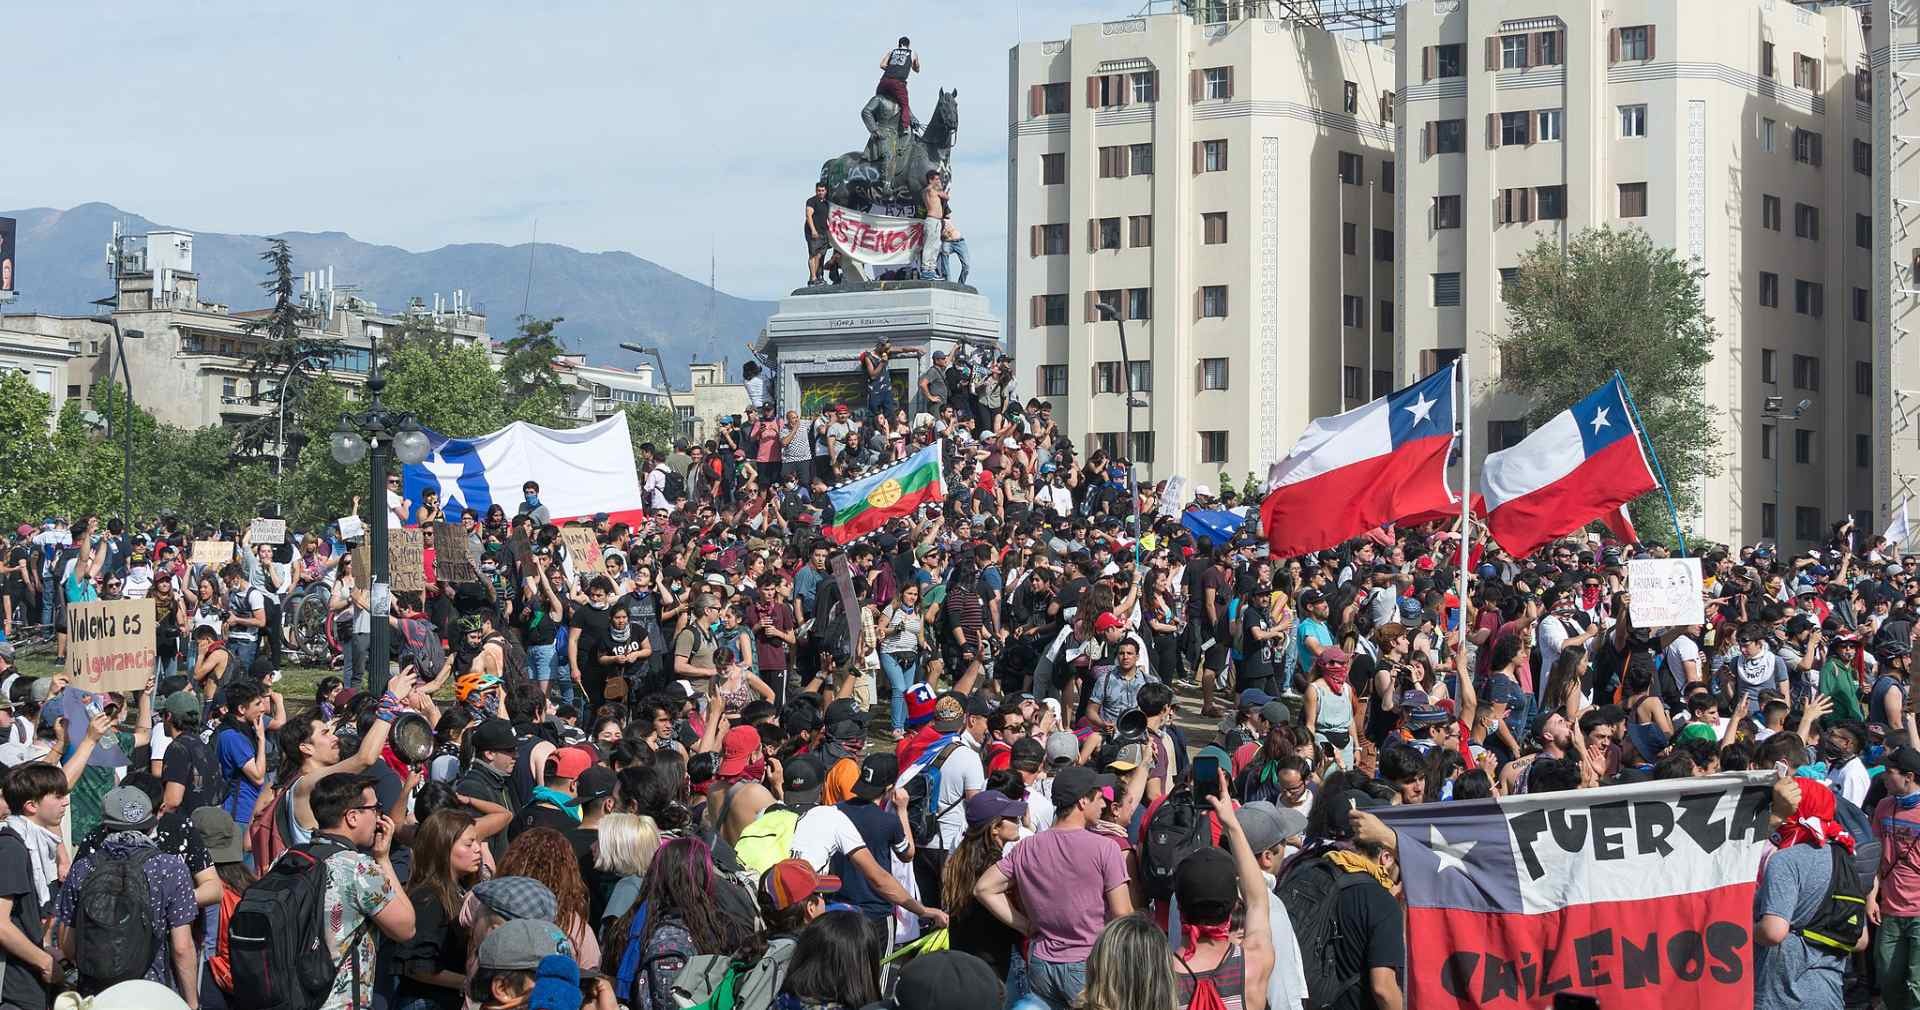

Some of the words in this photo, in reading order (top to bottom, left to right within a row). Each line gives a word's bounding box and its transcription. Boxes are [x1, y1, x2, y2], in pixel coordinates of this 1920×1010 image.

[69, 606, 116, 643] Violenta
[123, 614, 142, 635] es
[72, 651, 82, 677] tu
[1508, 785, 1774, 881] FUERZA
